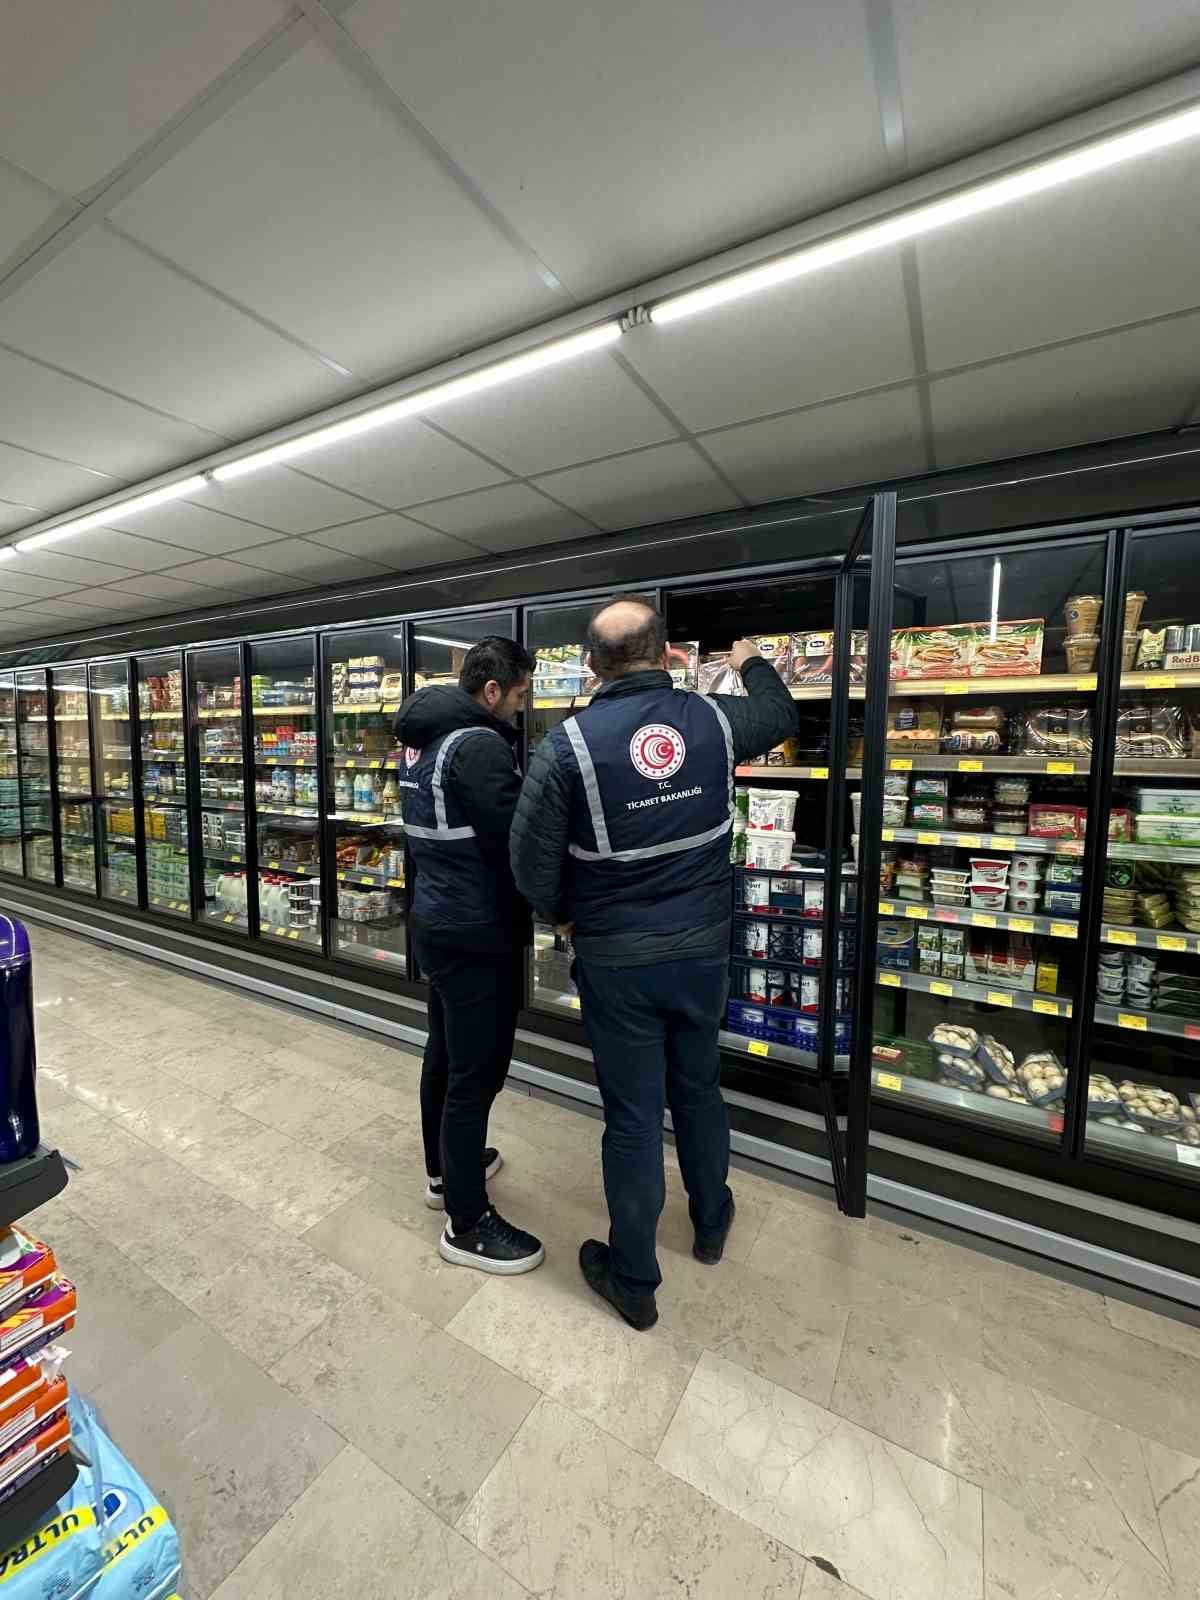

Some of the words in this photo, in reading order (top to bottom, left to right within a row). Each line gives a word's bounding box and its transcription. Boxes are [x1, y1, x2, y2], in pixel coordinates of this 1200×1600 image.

[1172, 655, 1191, 663] Red
[626, 796, 660, 810] TİCARET
[660, 786, 703, 803] BAKANLIĞI
